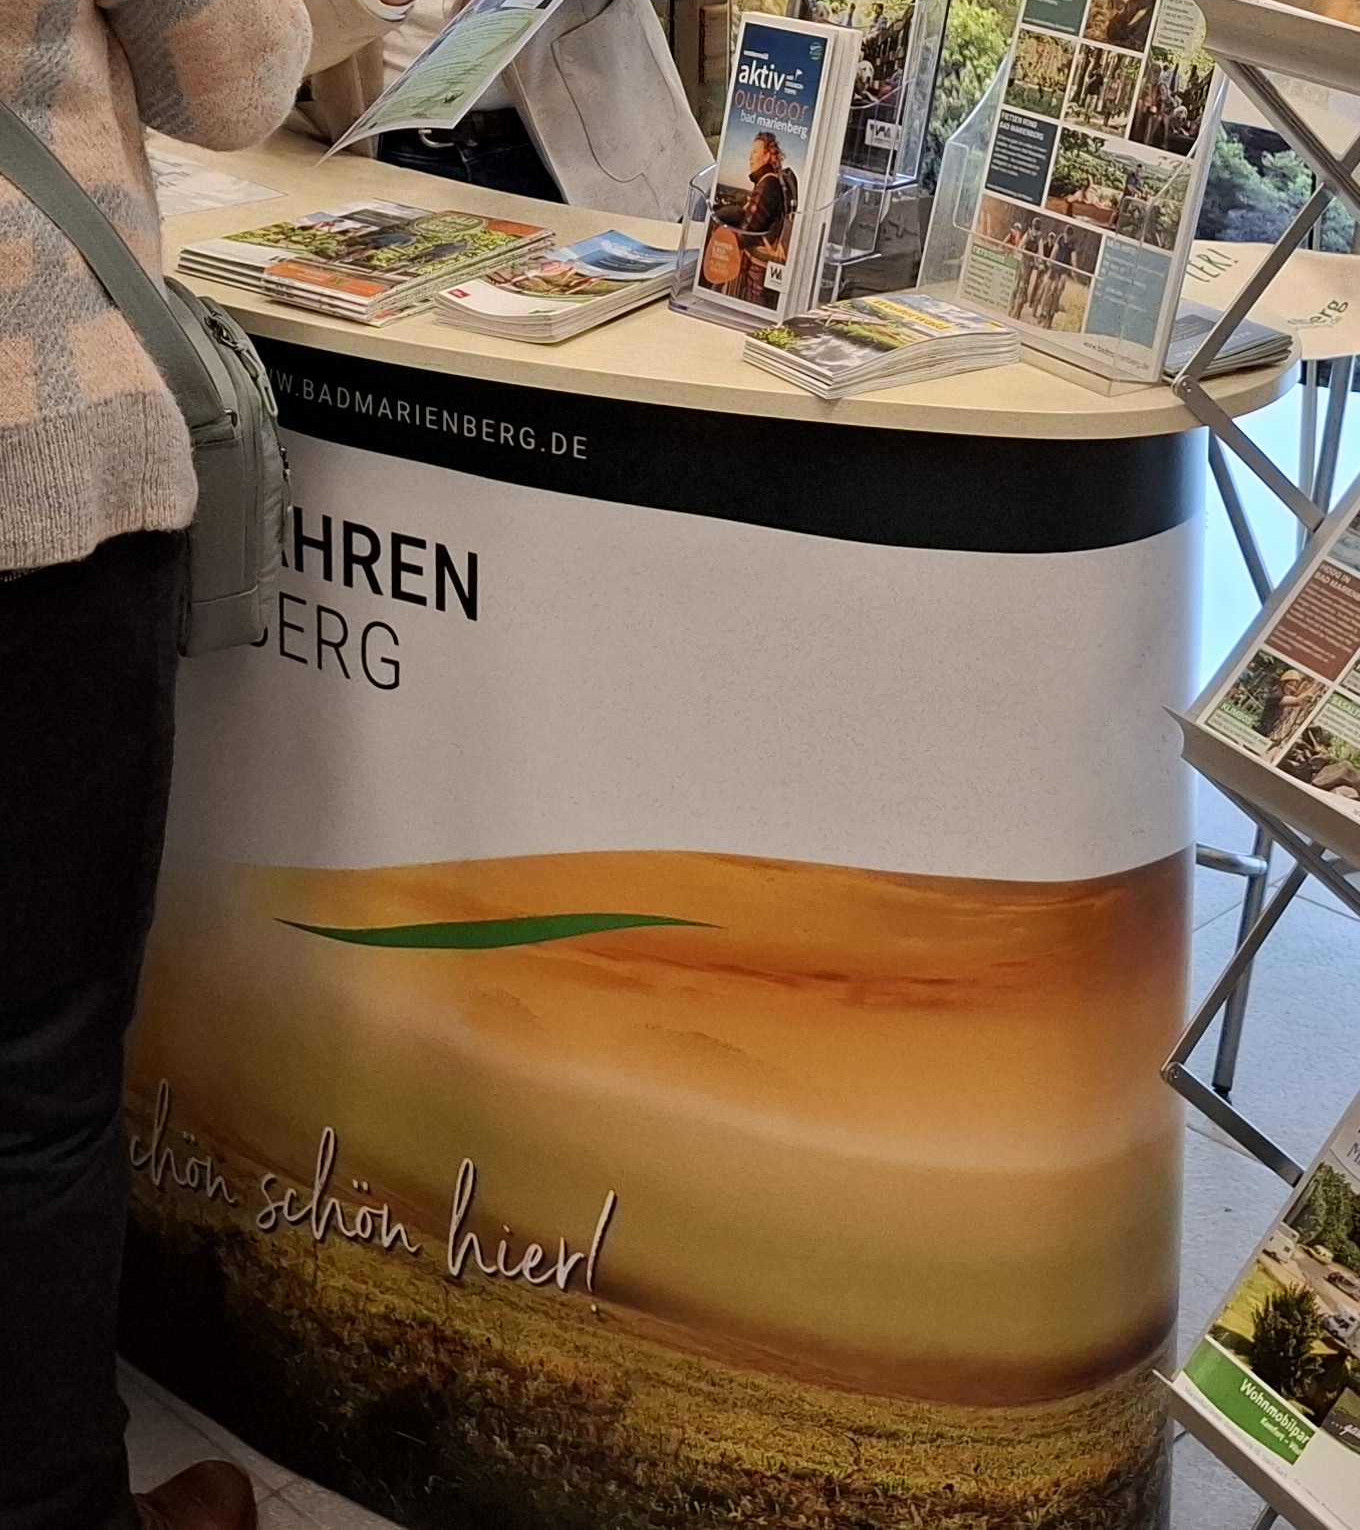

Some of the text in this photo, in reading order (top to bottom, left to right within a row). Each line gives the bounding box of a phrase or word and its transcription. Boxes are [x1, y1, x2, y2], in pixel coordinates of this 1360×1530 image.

[737, 58, 787, 92] aktiv
[734, 88, 810, 122] outdoor
[740, 109, 809, 139] bad marienberg
[281, 505, 479, 622] HREN
[1313, 571, 1331, 585] BAD
[250, 591, 401, 691] ERG
[255, 1126, 422, 1255] schön
